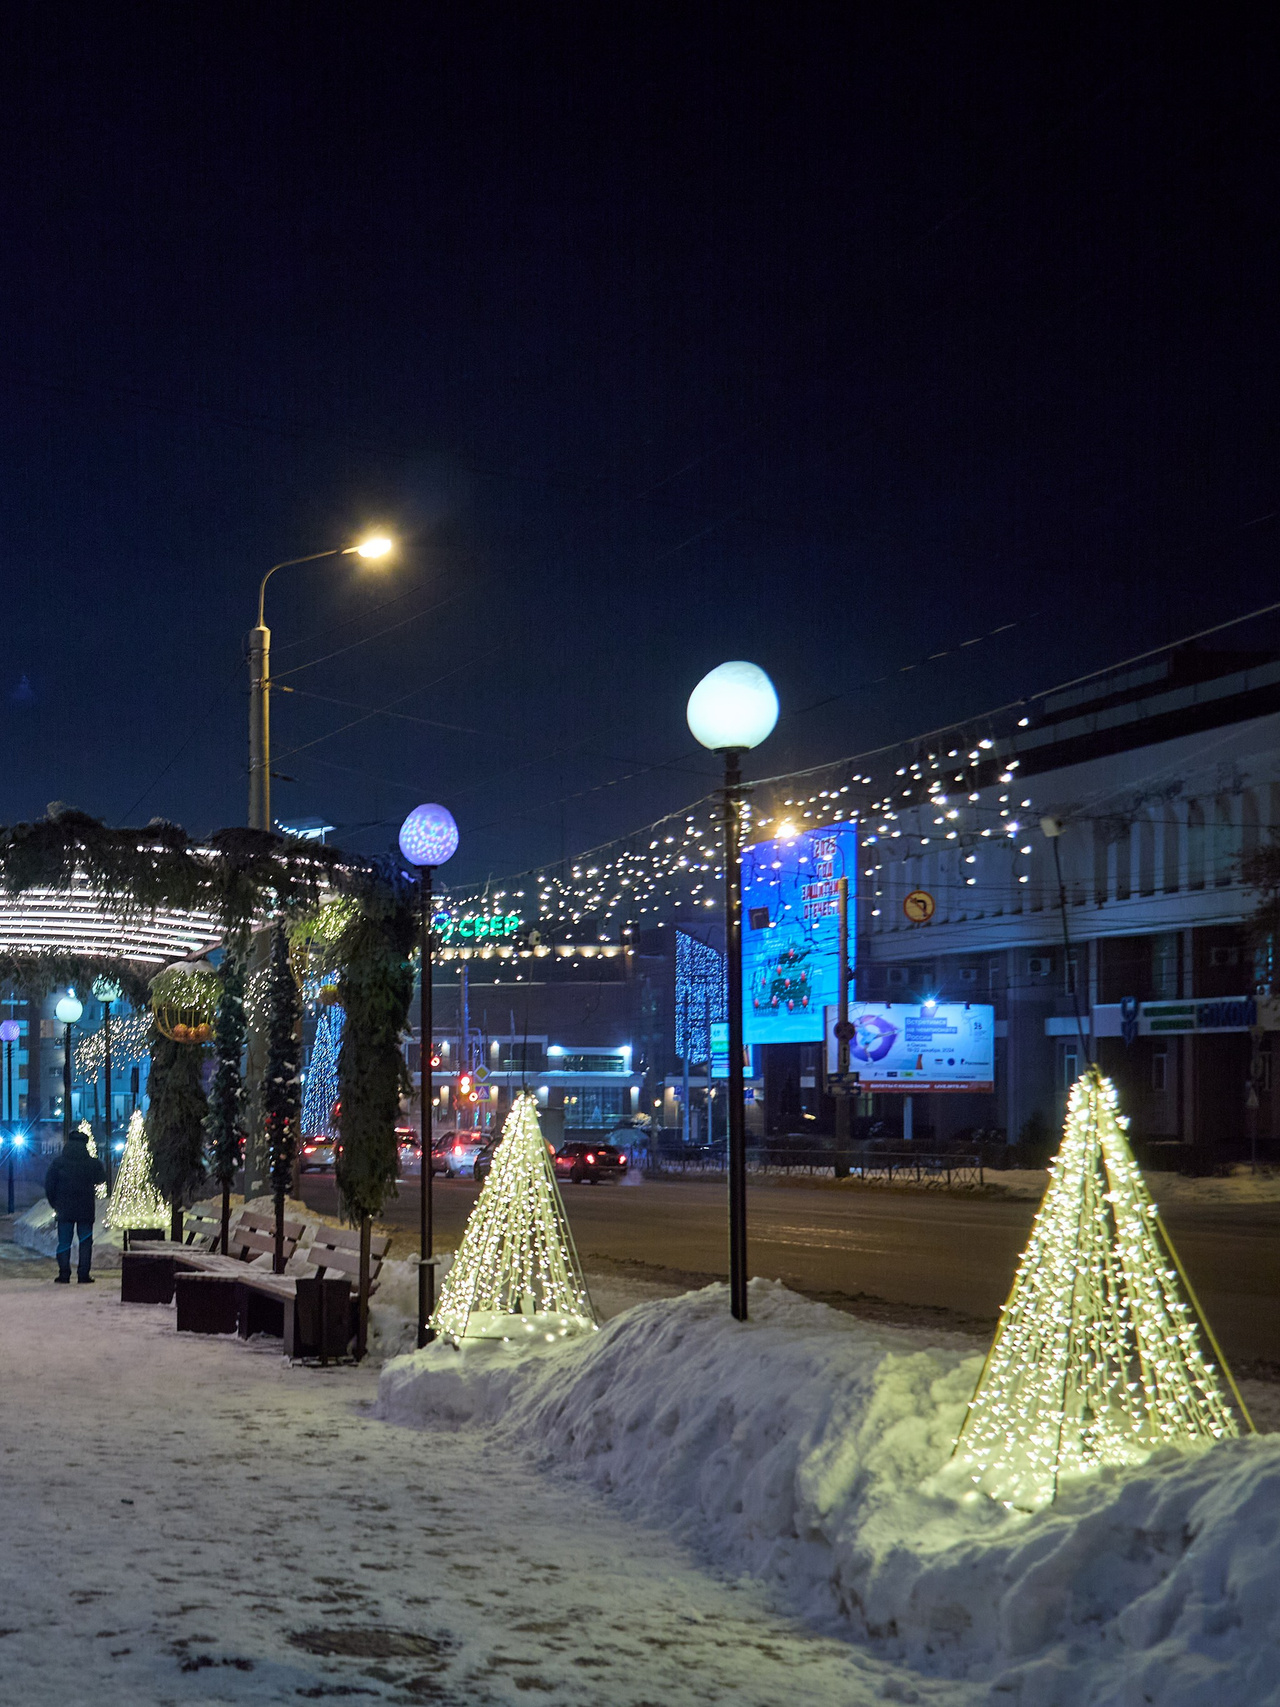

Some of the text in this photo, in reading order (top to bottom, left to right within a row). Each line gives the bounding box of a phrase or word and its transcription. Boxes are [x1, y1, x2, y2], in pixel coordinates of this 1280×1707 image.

[814, 836, 837, 858] 2025
[817, 861, 834, 879] ГОД
[459, 915, 519, 938] СБЕР
